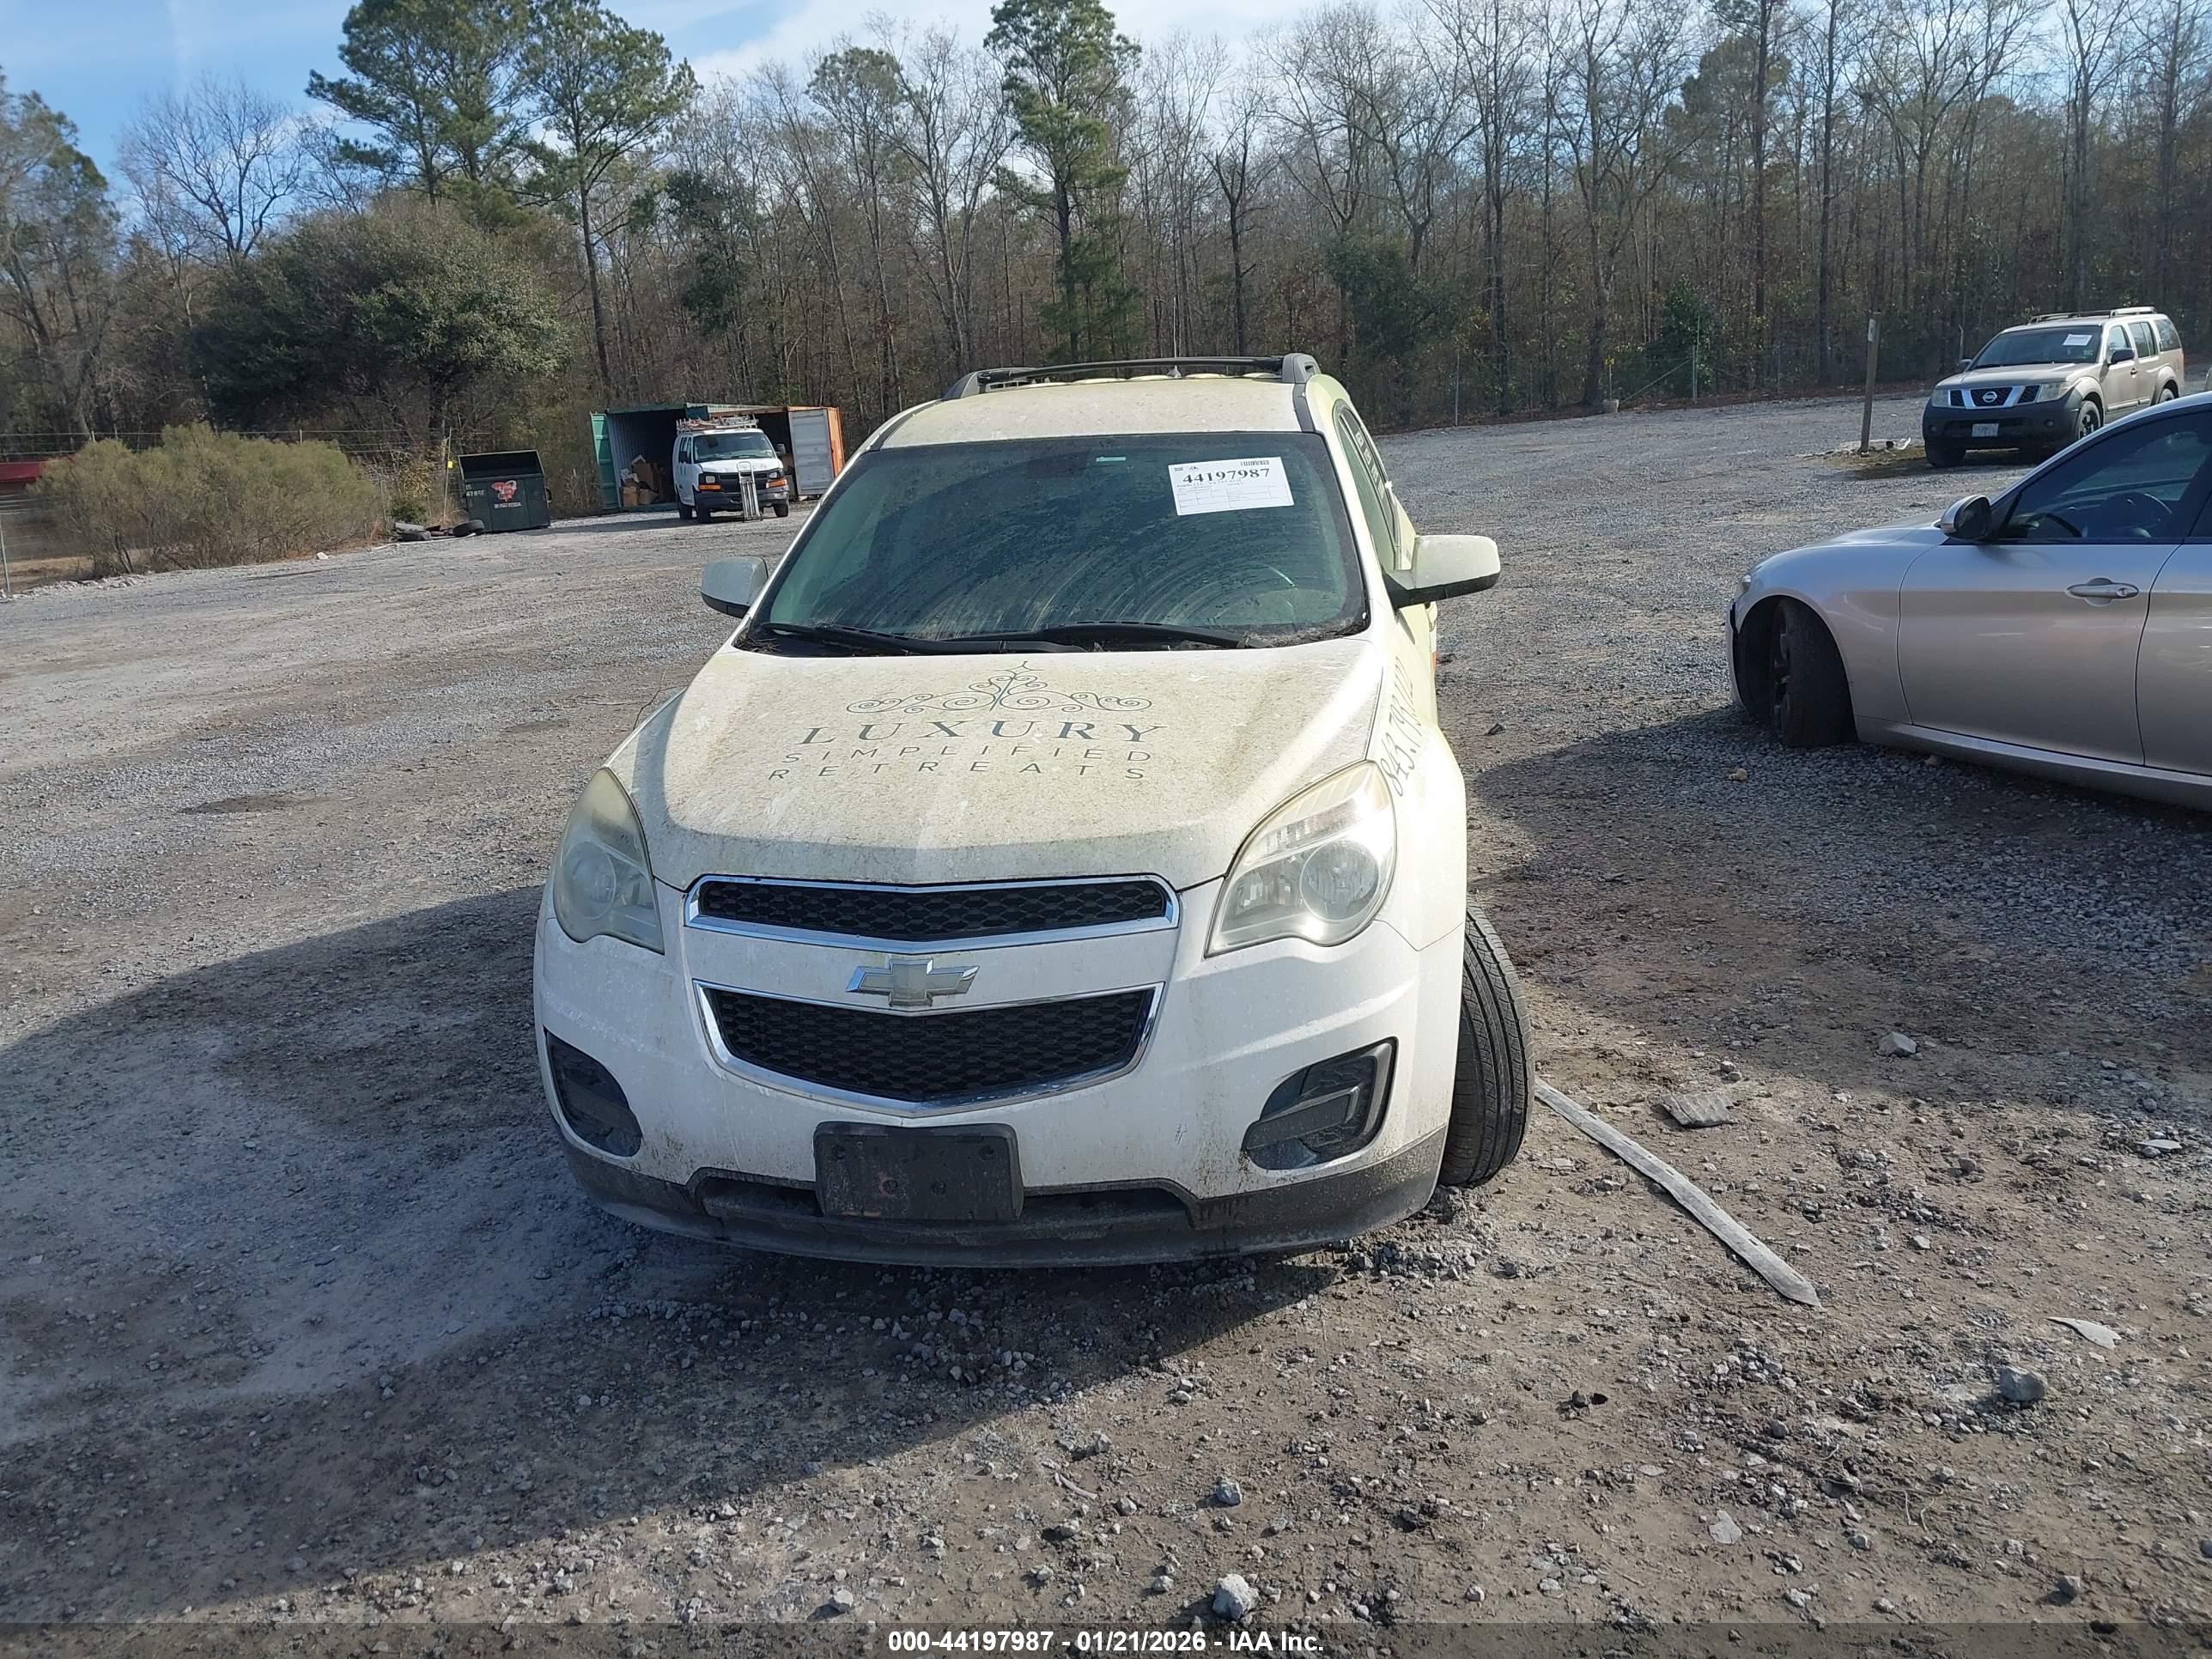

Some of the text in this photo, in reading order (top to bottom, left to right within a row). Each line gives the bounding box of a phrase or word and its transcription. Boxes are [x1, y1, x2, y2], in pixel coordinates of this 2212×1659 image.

[1183, 468, 1270, 483] 44197987
[798, 720, 1168, 745] LUXURY
[783, 745, 1152, 763] SIMPLIFIED
[769, 762, 1146, 781] RETREATS
